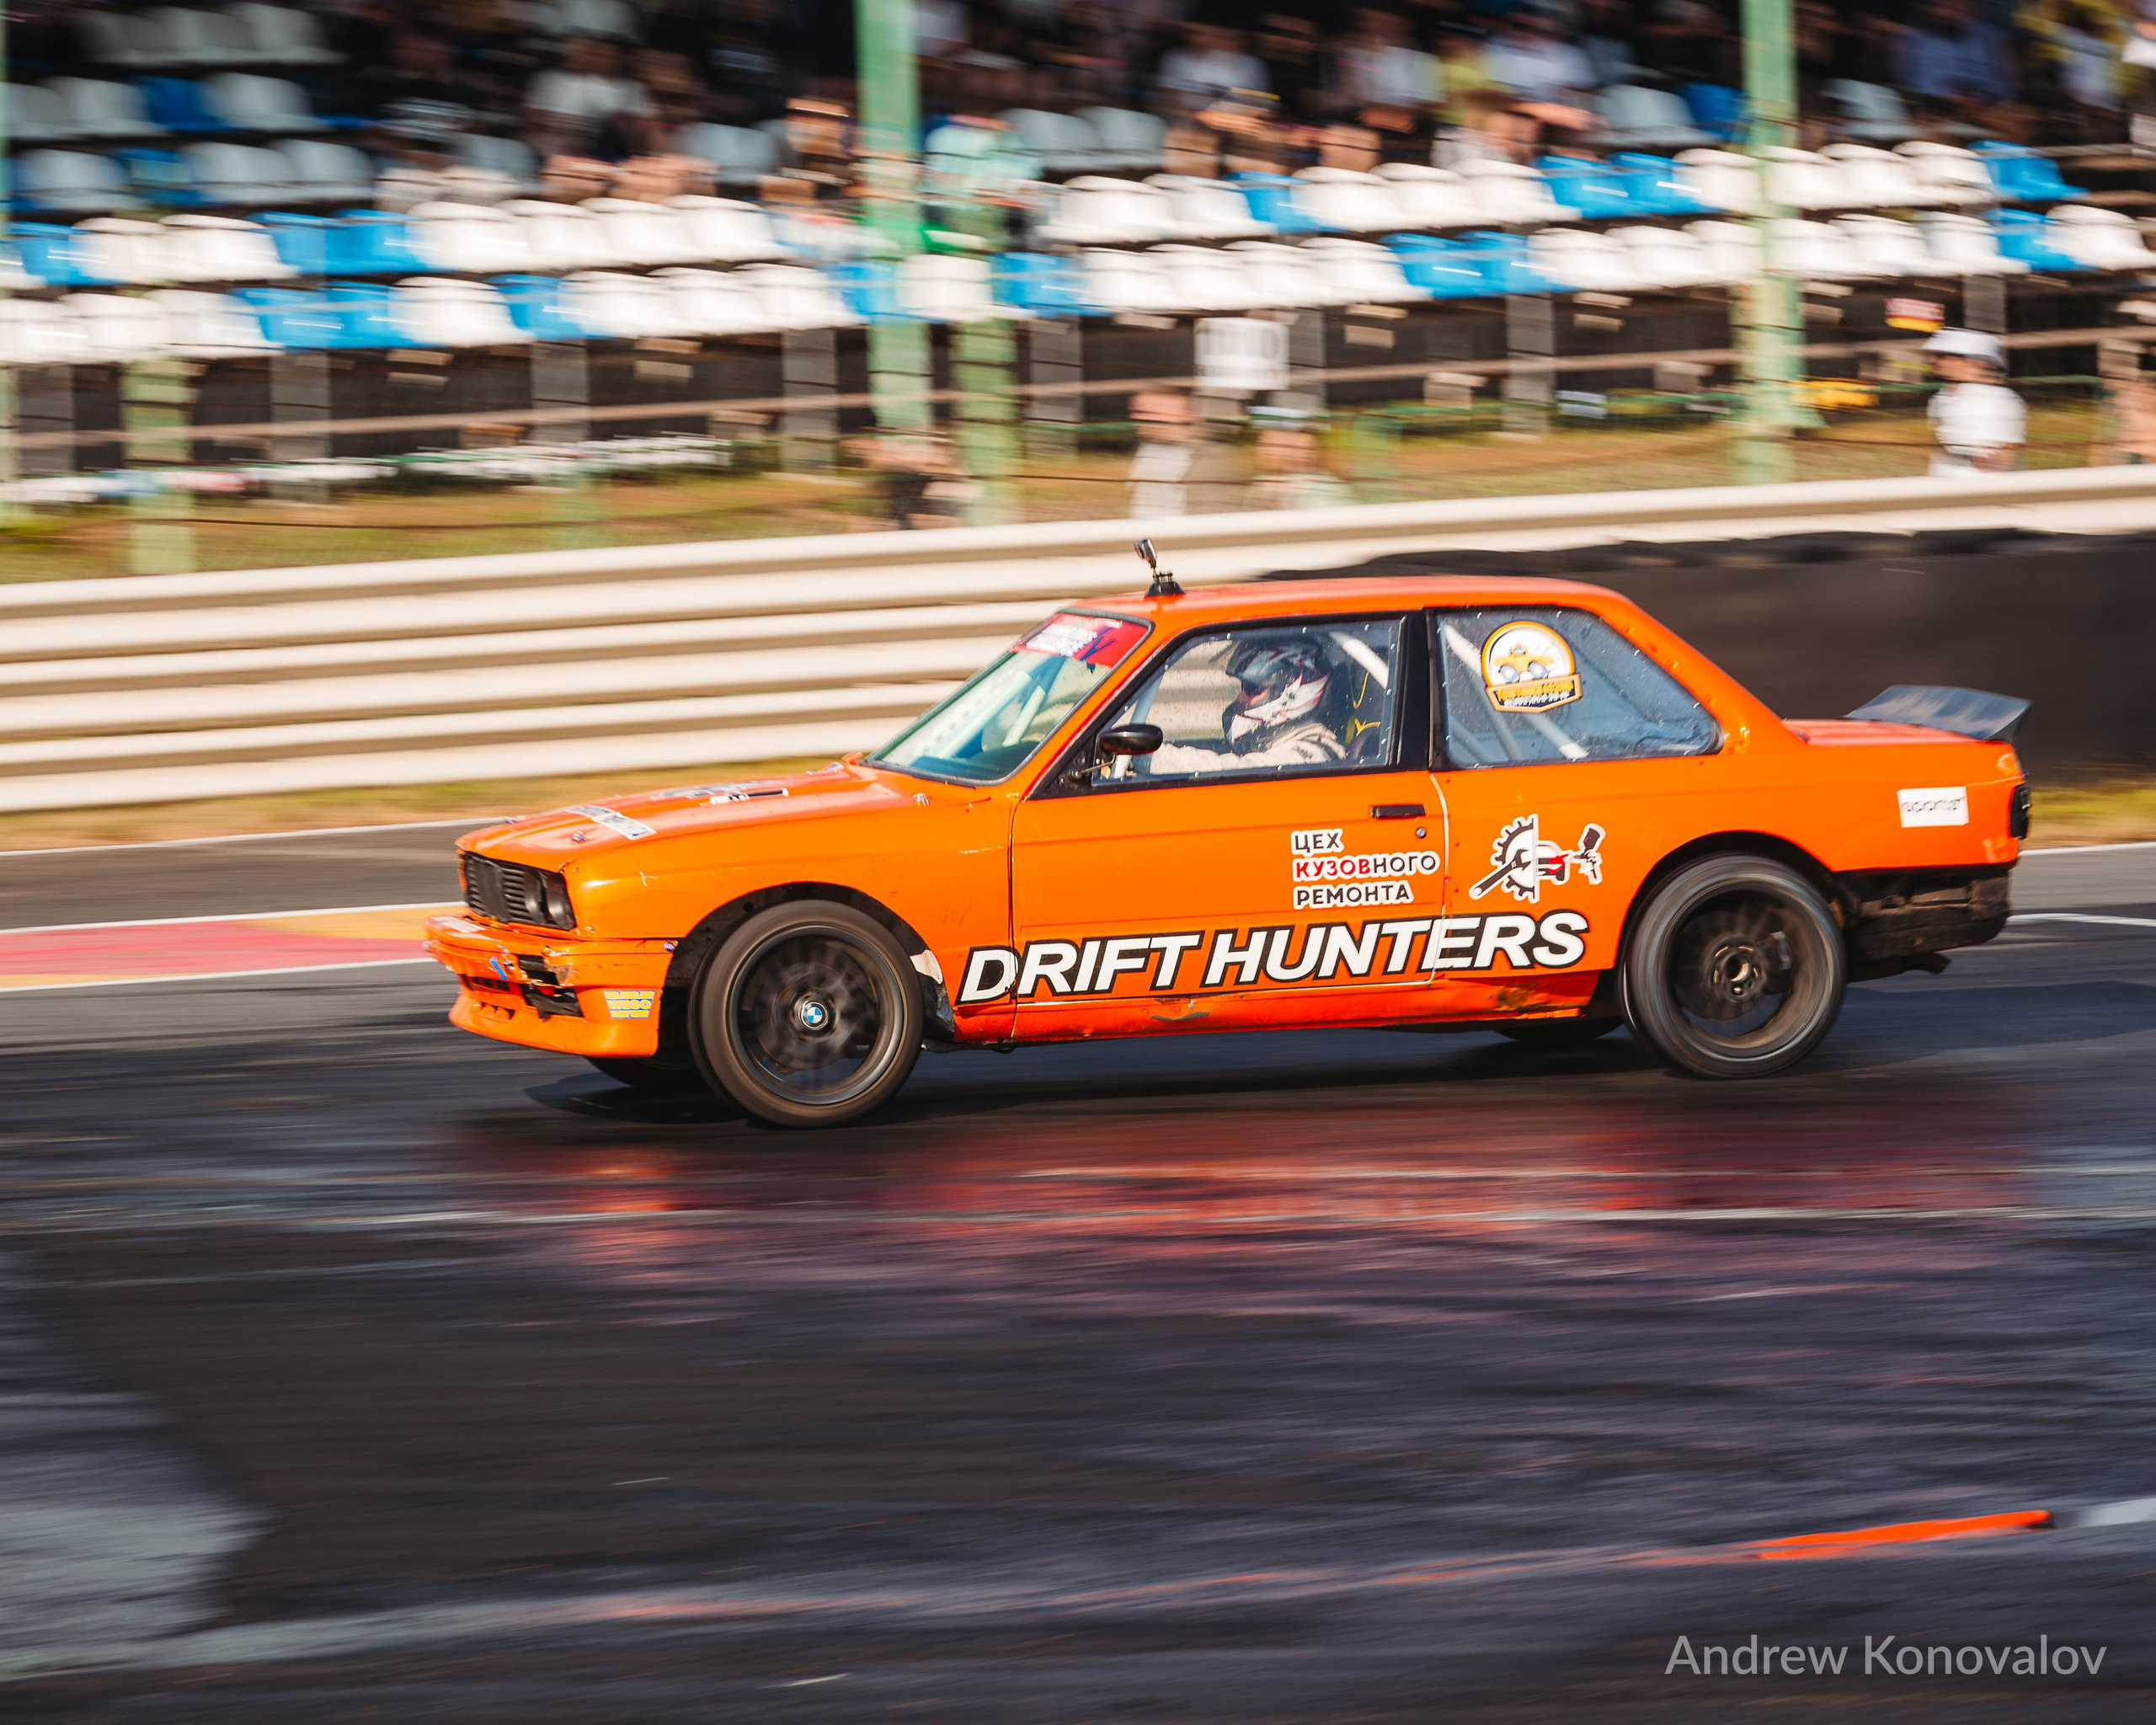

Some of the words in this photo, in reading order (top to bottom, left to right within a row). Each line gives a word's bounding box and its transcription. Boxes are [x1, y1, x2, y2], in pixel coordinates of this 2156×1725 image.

[1294, 831, 1340, 853] ЦЕХ
[1295, 854, 1436, 879] КУЗОВНОГО
[1296, 884, 1410, 906] РЕМОНТА
[958, 932, 1203, 1002] DRIFT
[1203, 911, 1589, 988] HUNTERS
[606, 999, 652, 1010] WEGO
